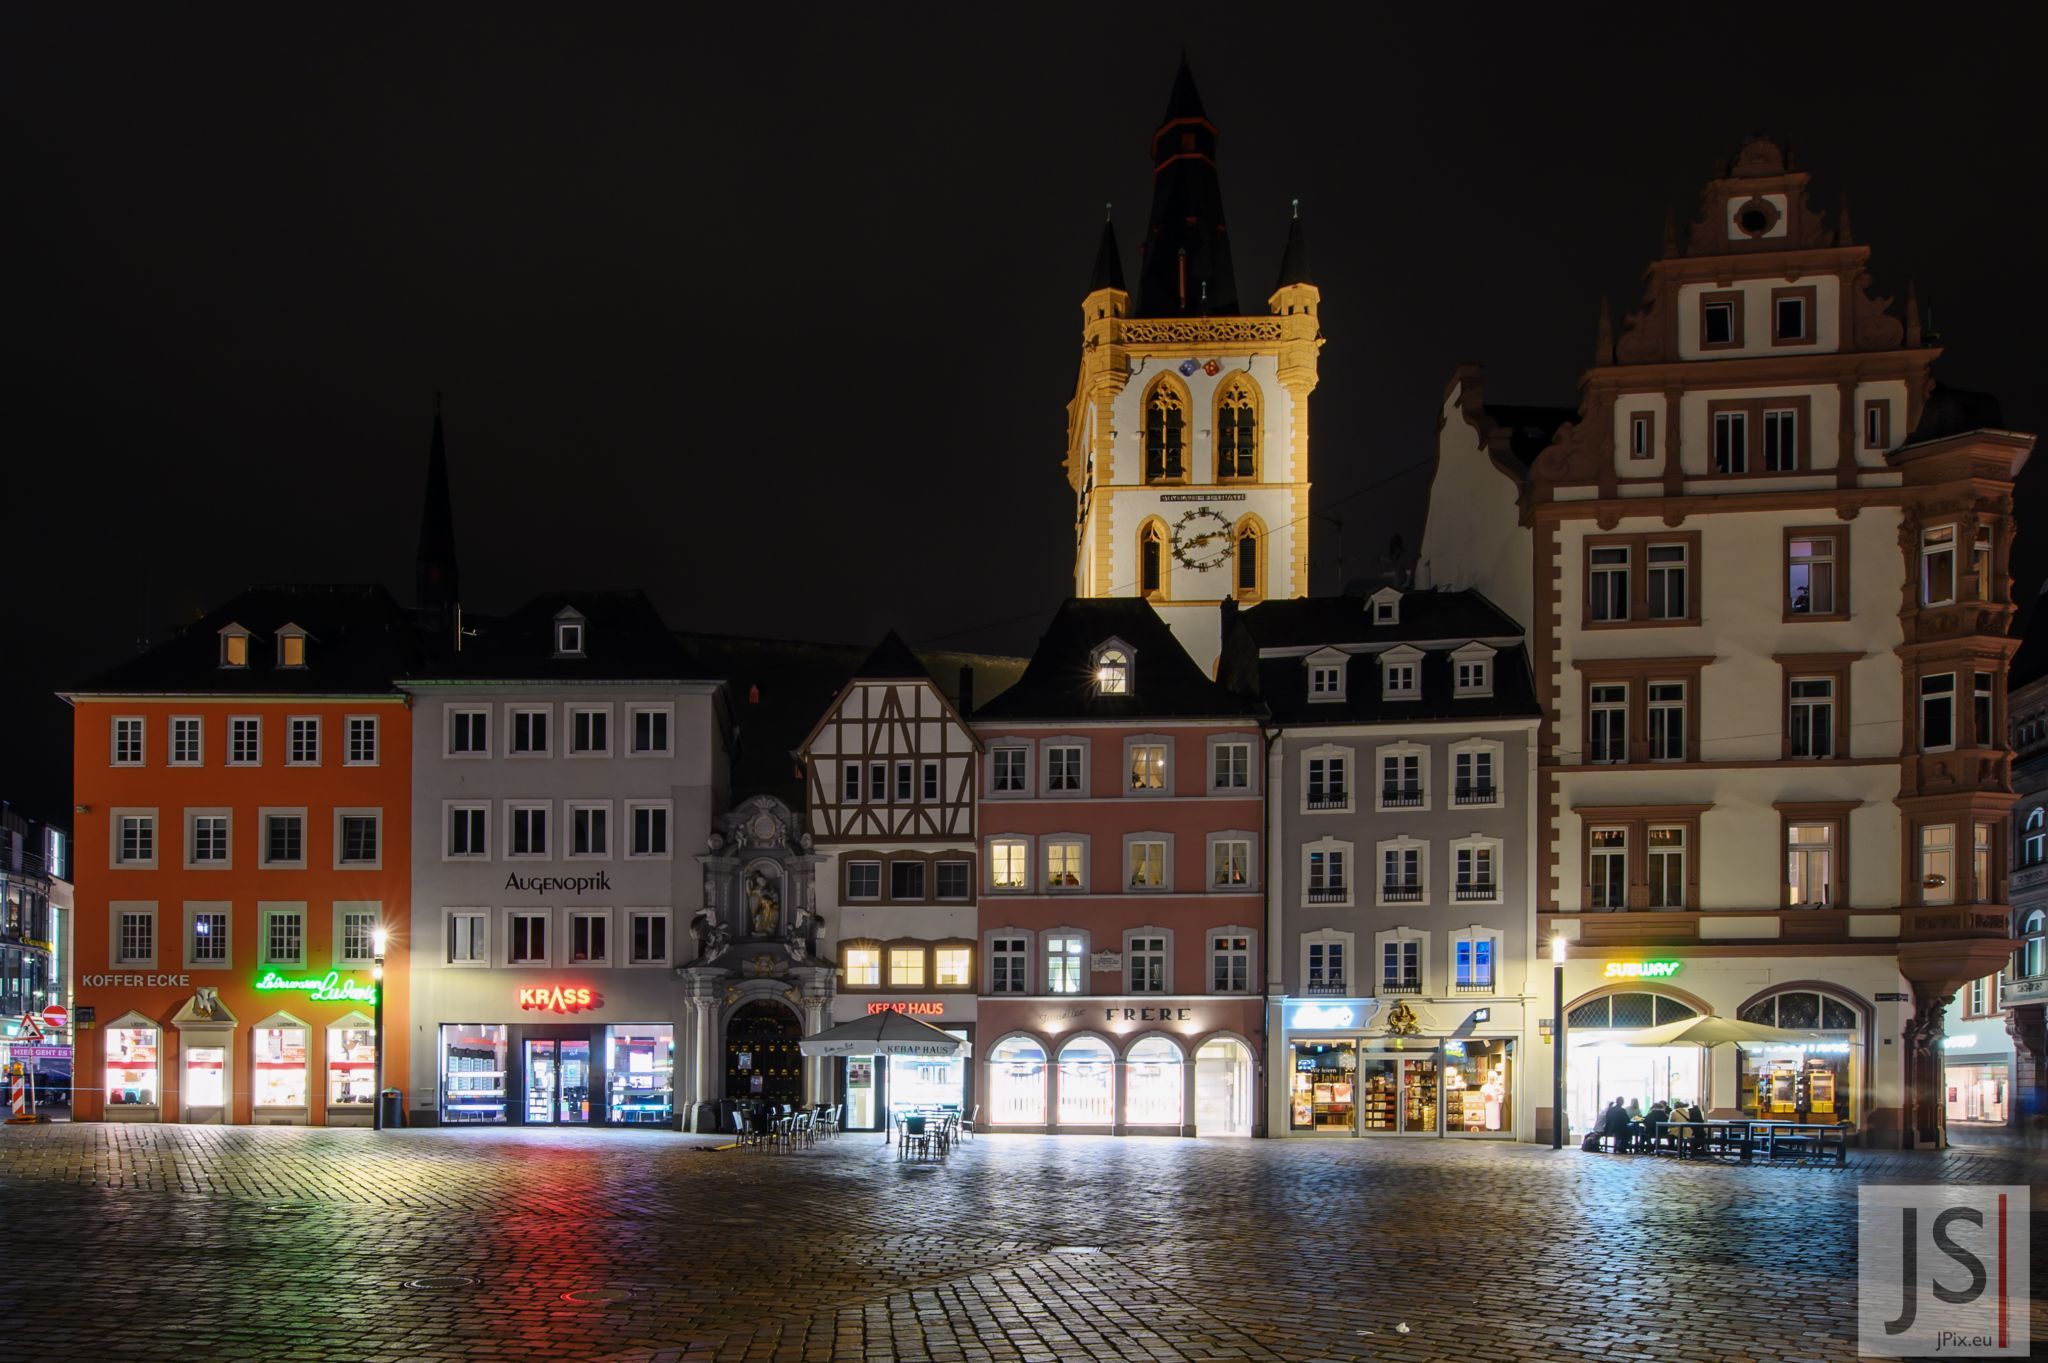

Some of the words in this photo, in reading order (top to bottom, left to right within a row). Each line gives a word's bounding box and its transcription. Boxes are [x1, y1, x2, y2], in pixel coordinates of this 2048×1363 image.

[1604, 962, 1679, 977] SUBWAY
[82, 974, 143, 987] KOFFER
[147, 974, 190, 987] ECKE
[519, 985, 591, 1010] KRASS
[908, 1002, 944, 1015] HAUS
[887, 1045, 920, 1054] KEBAP
[922, 1045, 949, 1055] HAUS
